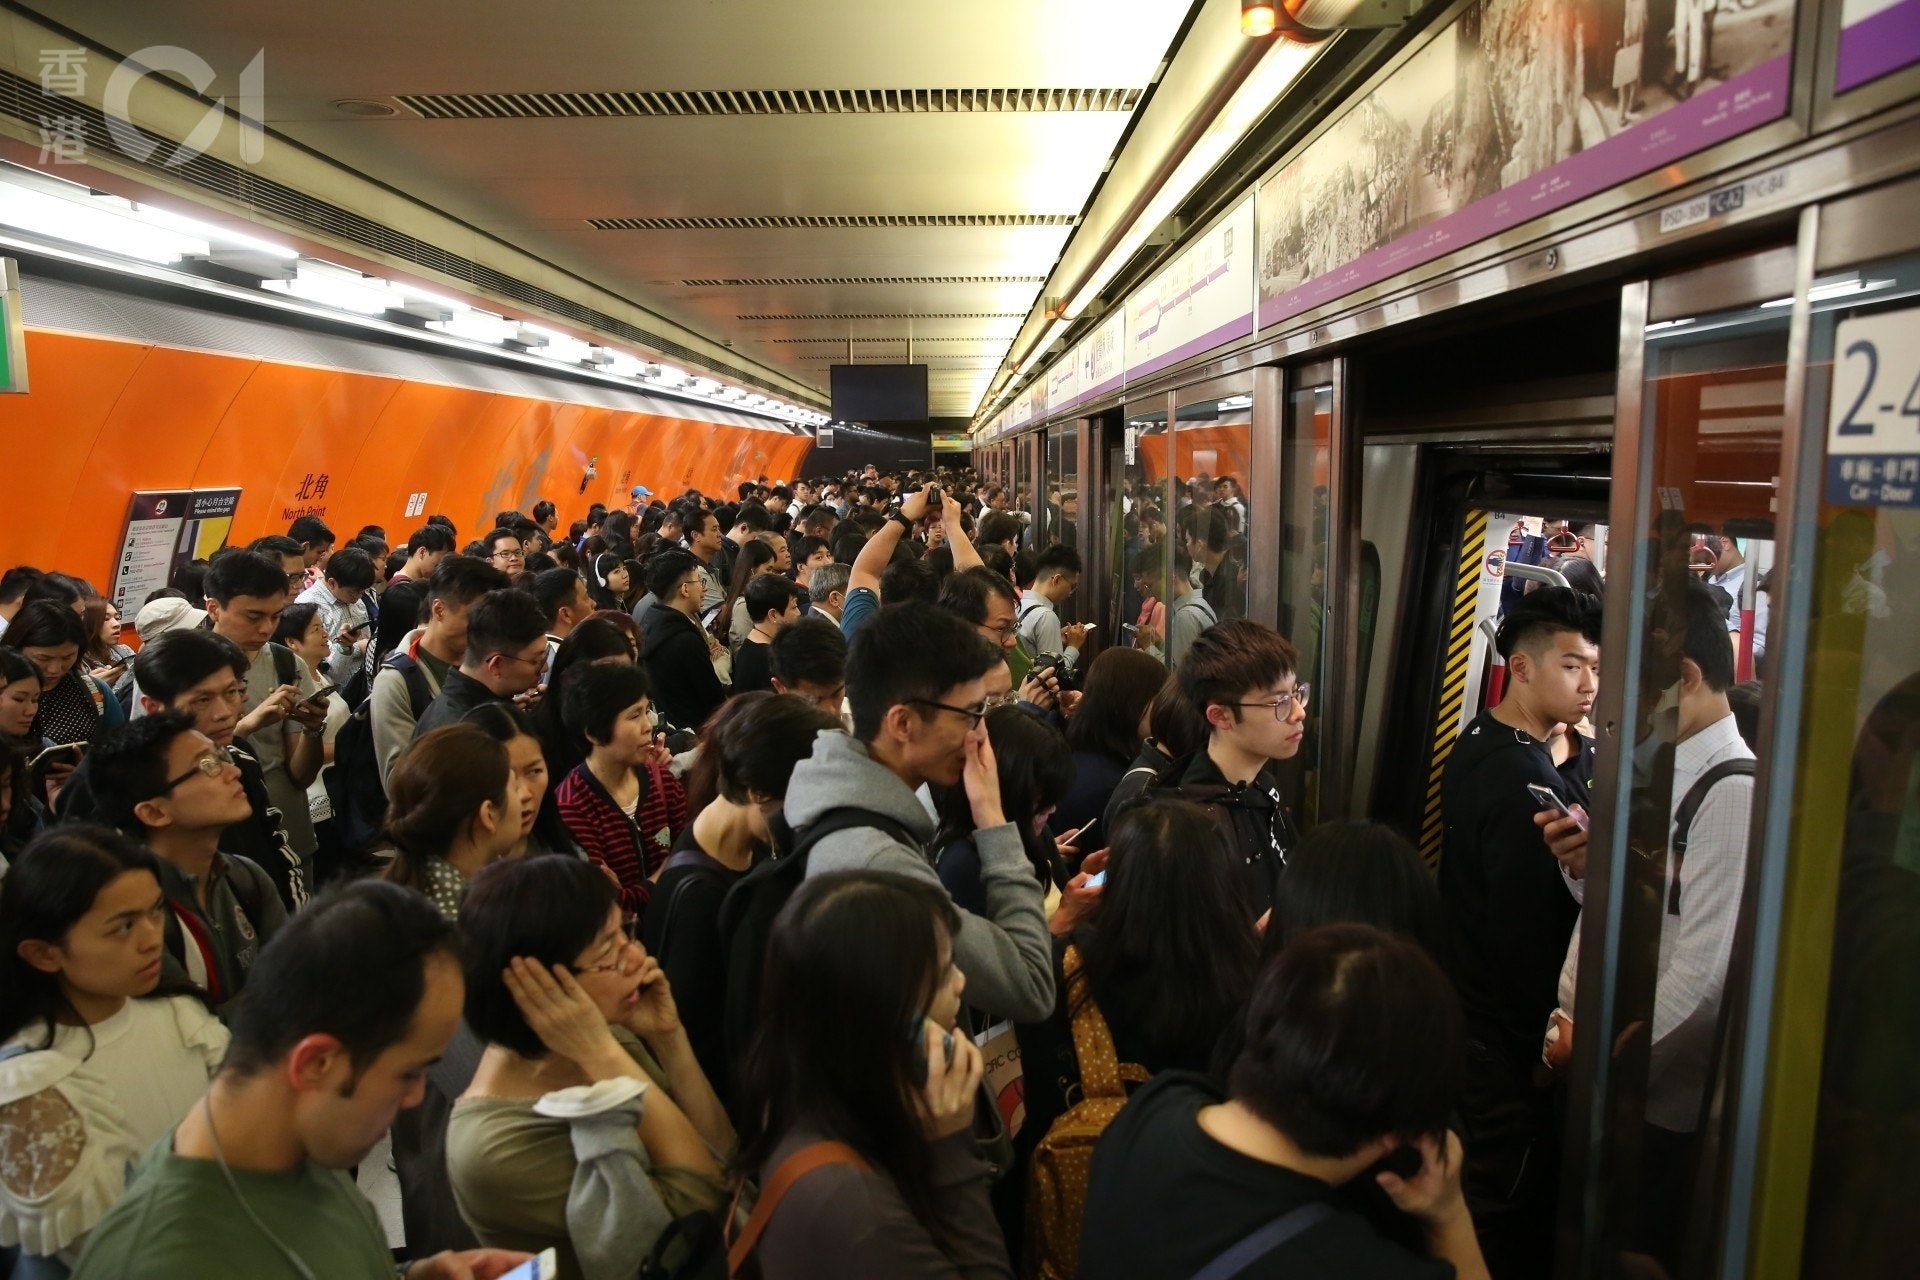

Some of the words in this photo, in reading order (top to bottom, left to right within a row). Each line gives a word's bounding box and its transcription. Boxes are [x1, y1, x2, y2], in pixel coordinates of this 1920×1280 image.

[294, 473, 329, 502] 北角
[281, 507, 305, 521] North
[306, 505, 327, 519] Point
